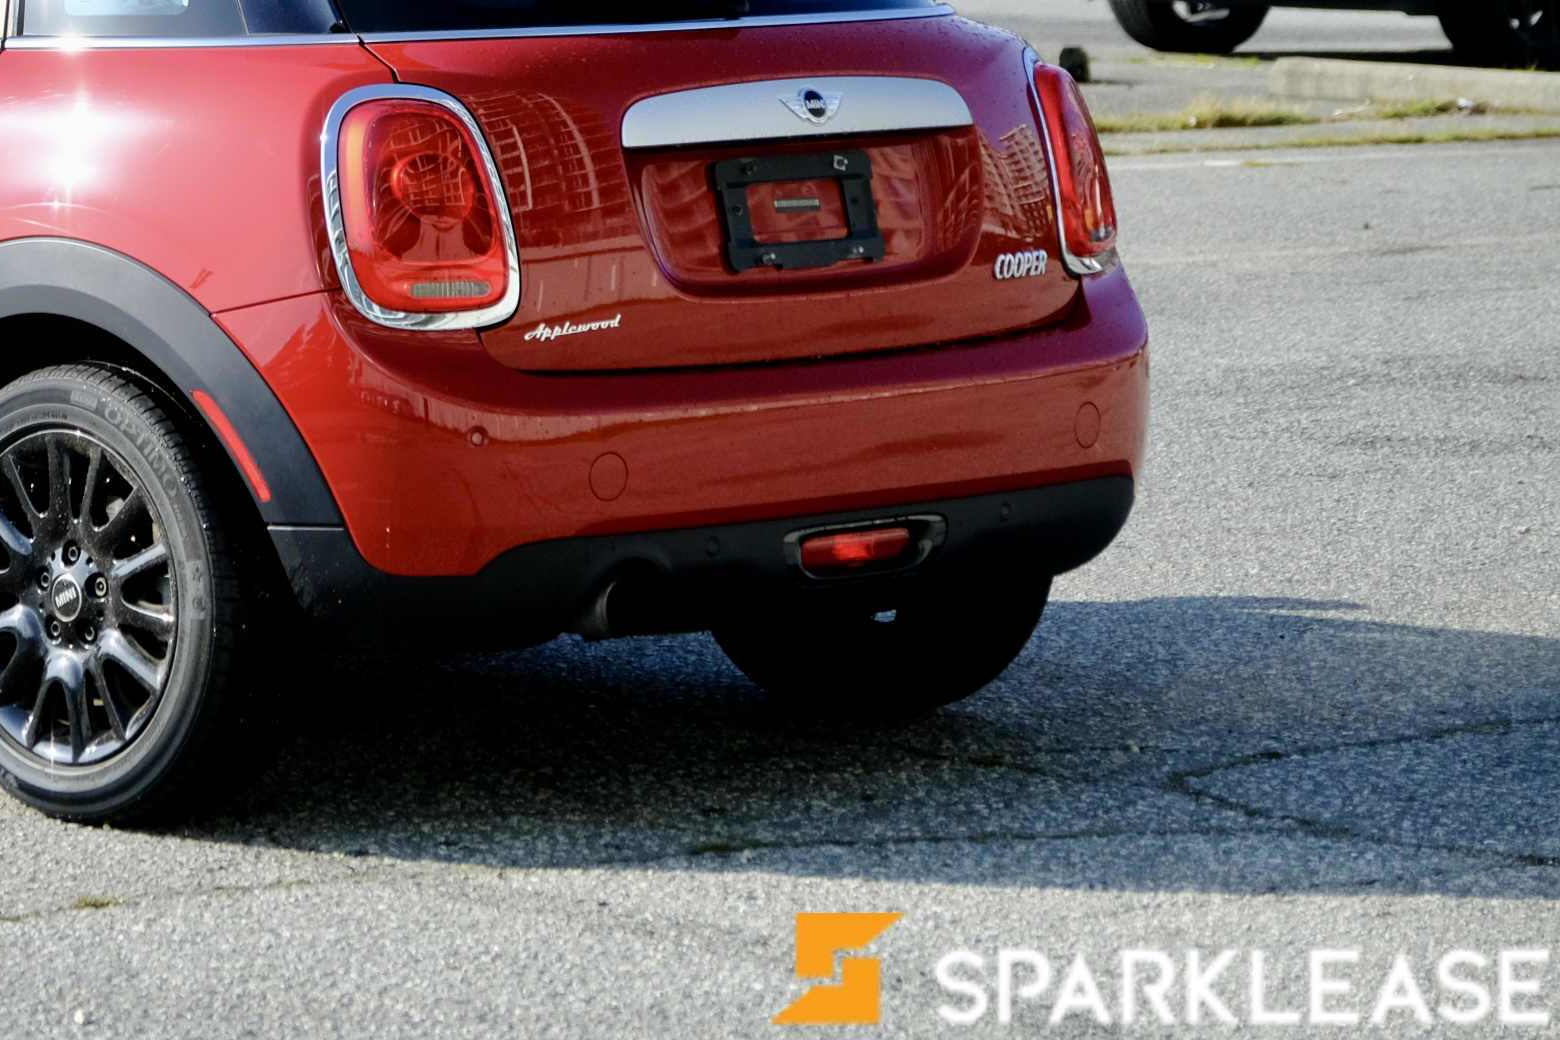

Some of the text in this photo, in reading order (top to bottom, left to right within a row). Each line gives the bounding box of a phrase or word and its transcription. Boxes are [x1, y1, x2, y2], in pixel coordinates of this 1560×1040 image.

[994, 249, 1048, 280] COOPER
[524, 313, 622, 341] Applewood
[55, 586, 77, 608] MINI
